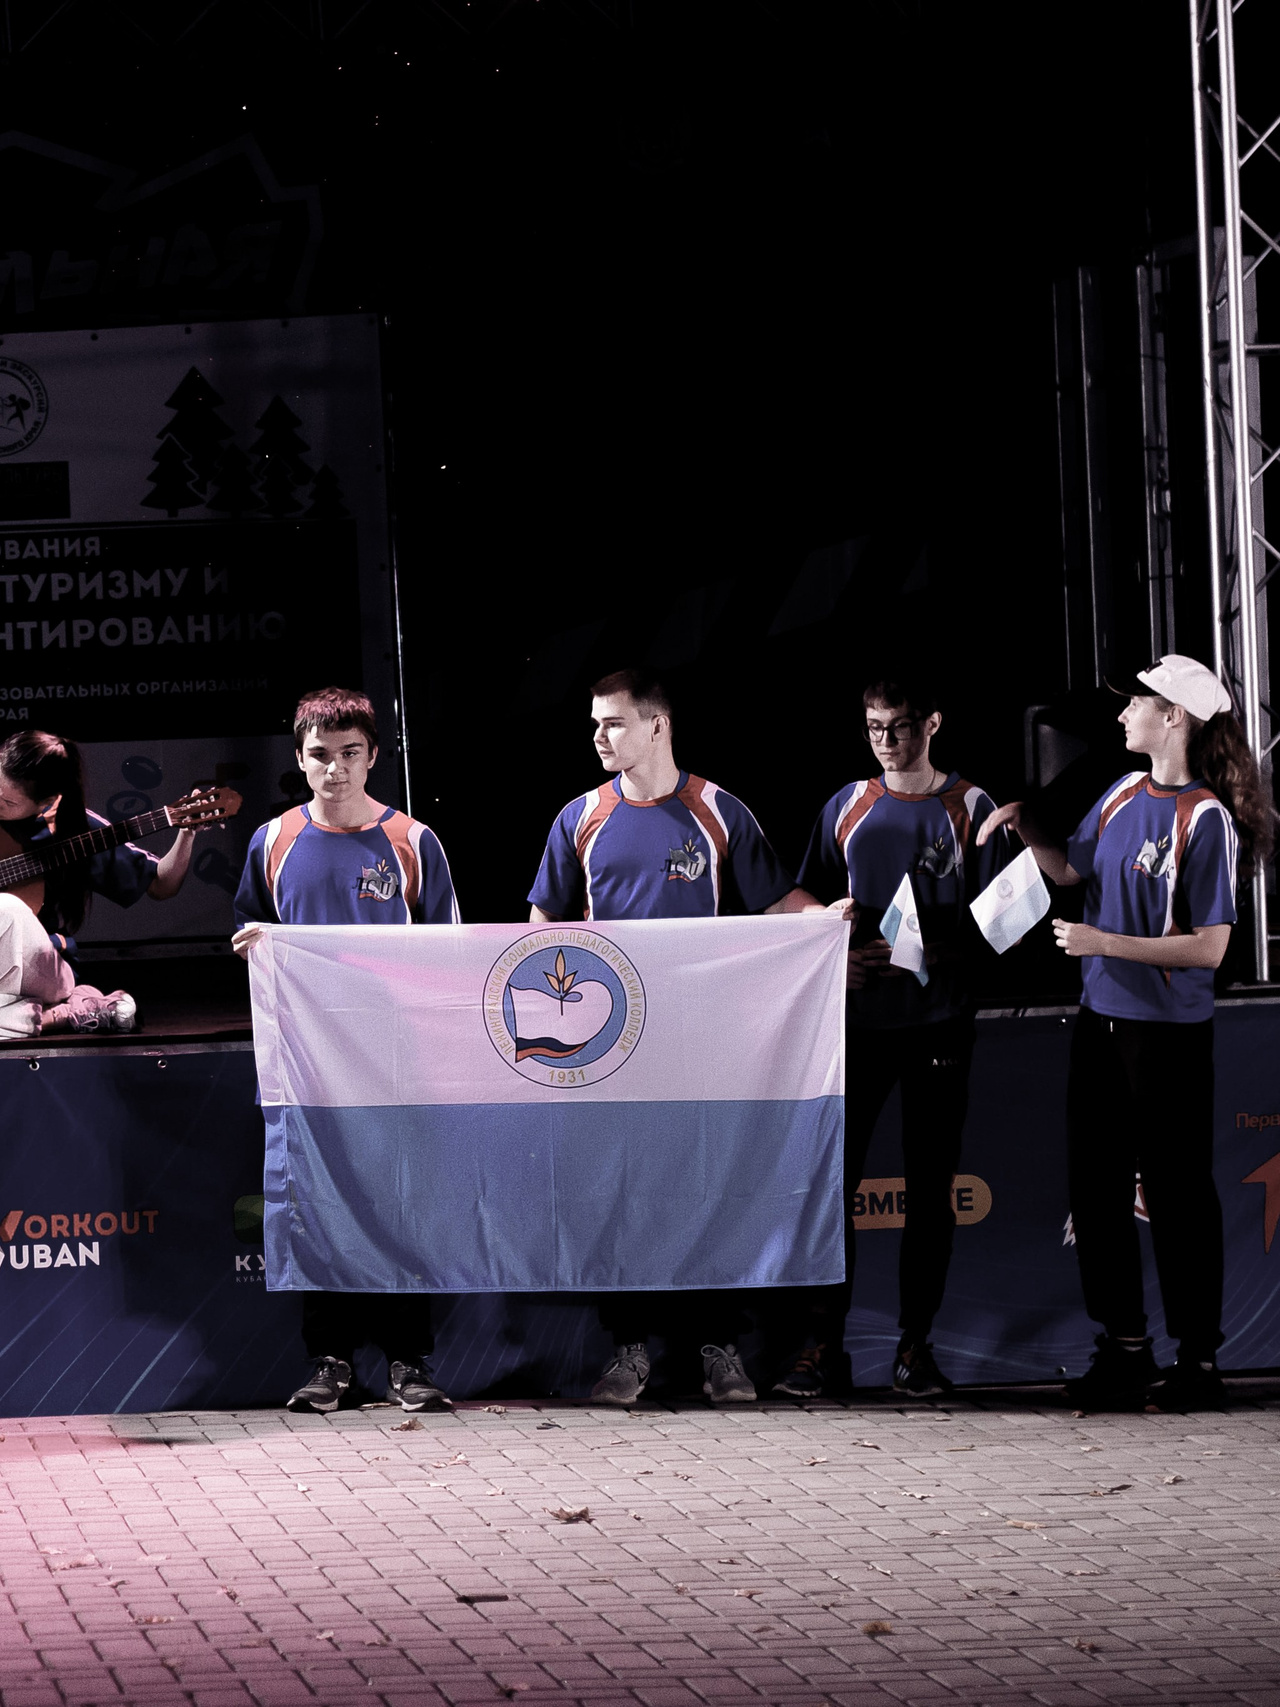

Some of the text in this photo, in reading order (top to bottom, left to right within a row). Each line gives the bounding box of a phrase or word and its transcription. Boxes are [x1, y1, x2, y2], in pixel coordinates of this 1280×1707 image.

[0, 566, 190, 604] ТУРИЗМУ
[204, 566, 230, 596] И
[135, 674, 269, 696] ОРГАНИЗАЦИЙ
[488, 966, 515, 1056] ЛЕНИНГРАДСКИЙ
[617, 1002, 642, 1054] КОЛЛЕДЖ
[548, 1069, 586, 1083] 1931
[852, 1188, 974, 1216] ВМЕЕ
